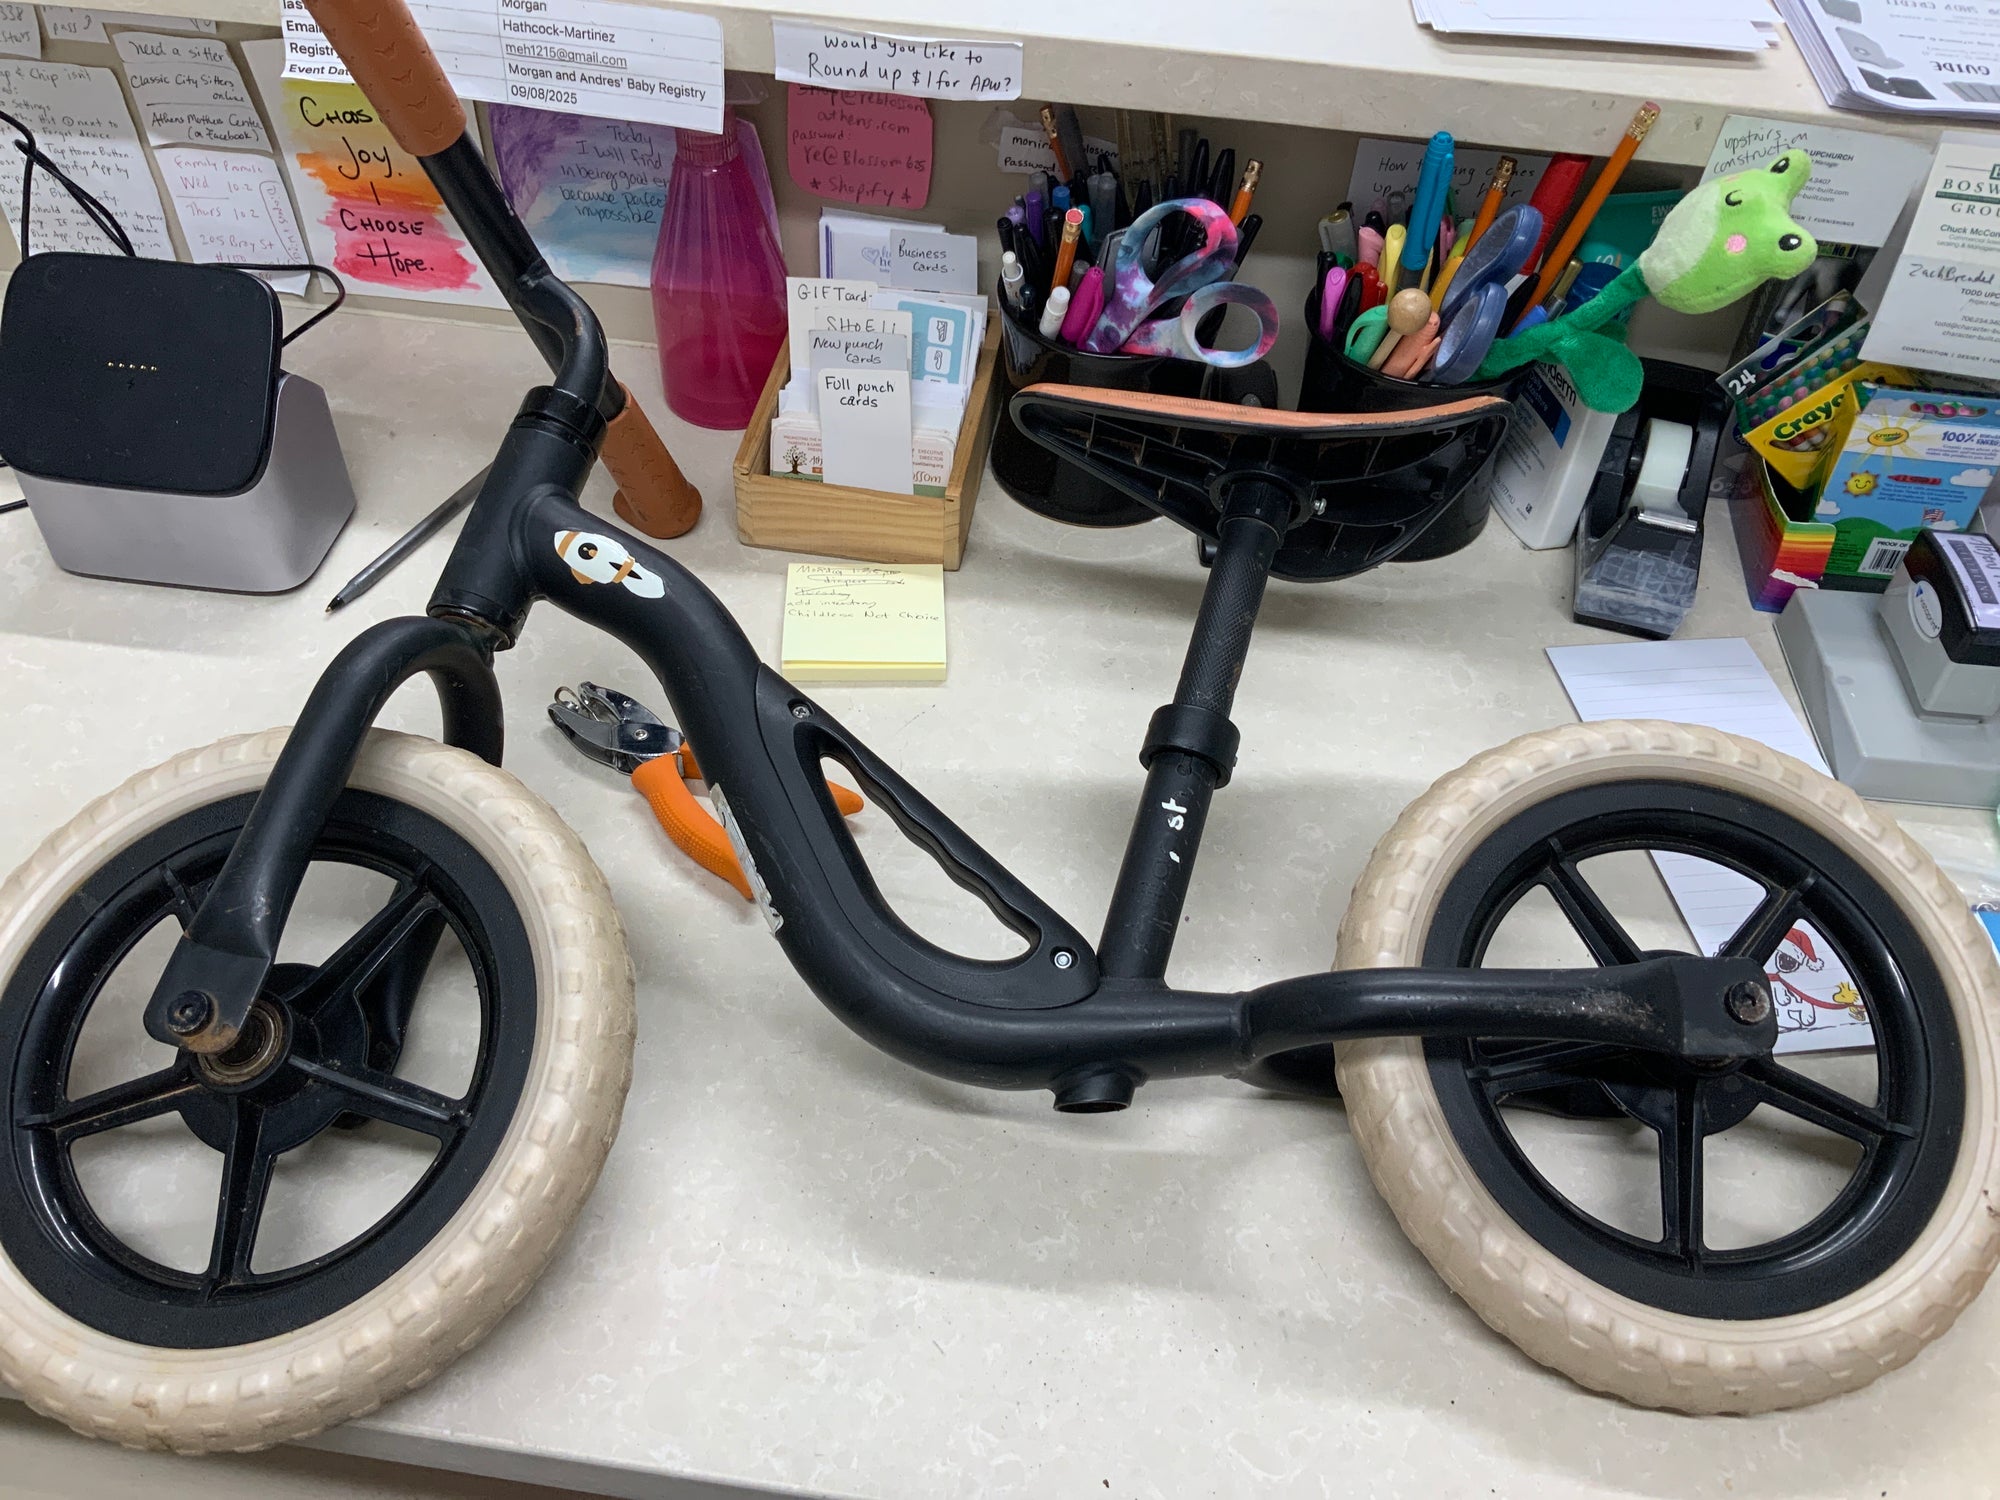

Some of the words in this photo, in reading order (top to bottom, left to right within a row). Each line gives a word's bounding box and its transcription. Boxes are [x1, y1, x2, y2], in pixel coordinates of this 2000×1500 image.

[501, 0, 547, 12] Morgan
[502, 19, 616, 43] Hathcock-Martinez
[188, 47, 225, 63] sitter
[824, 35, 878, 50] Would
[888, 42, 917, 58] you
[965, 49, 983, 66] to
[289, 64, 325, 75] Event
[328, 65, 351, 76] Dat
[807, 52, 869, 79] Round
[878, 64, 902, 91] up
[935, 70, 961, 89] for
[1930, 60, 1991, 76] GUIDE
[30, 67, 58, 88] Chip
[130, 74, 170, 89] Classic
[175, 74, 199, 88] City
[508, 62, 553, 80] Morgan
[555, 69, 577, 82] and
[580, 71, 624, 88] Andres'
[627, 78, 656, 95] Baby
[659, 82, 706, 101] Registry
[510, 84, 578, 105] 09/08/2025
[299, 96, 383, 127] CHOOS
[576, 140, 589, 155] I
[606, 125, 654, 157] Today
[1810, 150, 1855, 161] UPCHURCH
[1378, 157, 1409, 173] How
[180, 175, 209, 190] Wed
[559, 185, 617, 204] because
[829, 175, 894, 207] Shopify
[575, 205, 657, 224] impossible
[1961, 288, 1983, 297] TODD
[813, 336, 841, 350] New
[845, 337, 884, 351] punch
[857, 381, 895, 396] punch
[1728, 368, 1758, 396] 24
[1941, 430, 1978, 443] 100%
